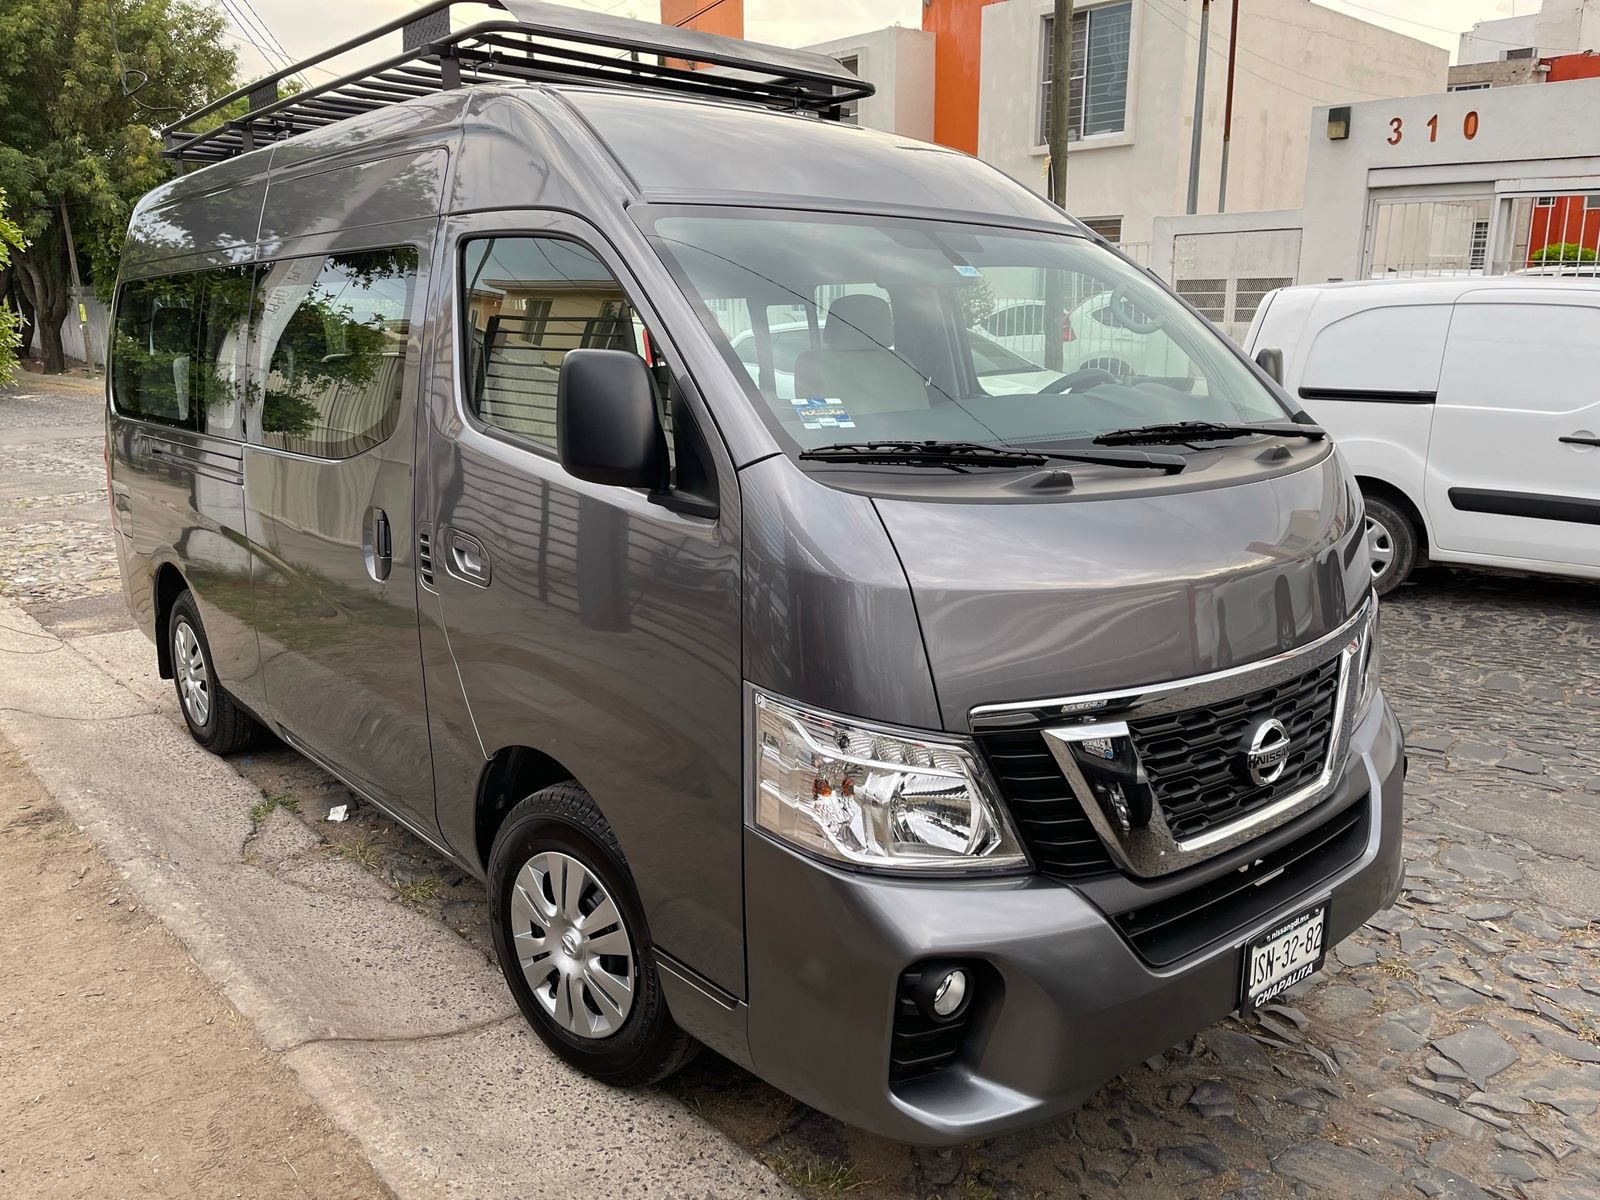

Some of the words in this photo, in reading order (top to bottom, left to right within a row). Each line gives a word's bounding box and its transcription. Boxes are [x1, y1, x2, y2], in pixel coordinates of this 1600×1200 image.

[1386, 110, 1479, 146] 310
[1249, 921, 1323, 989] JSN-32-82
[1255, 962, 1313, 1008] CHAPALITA
